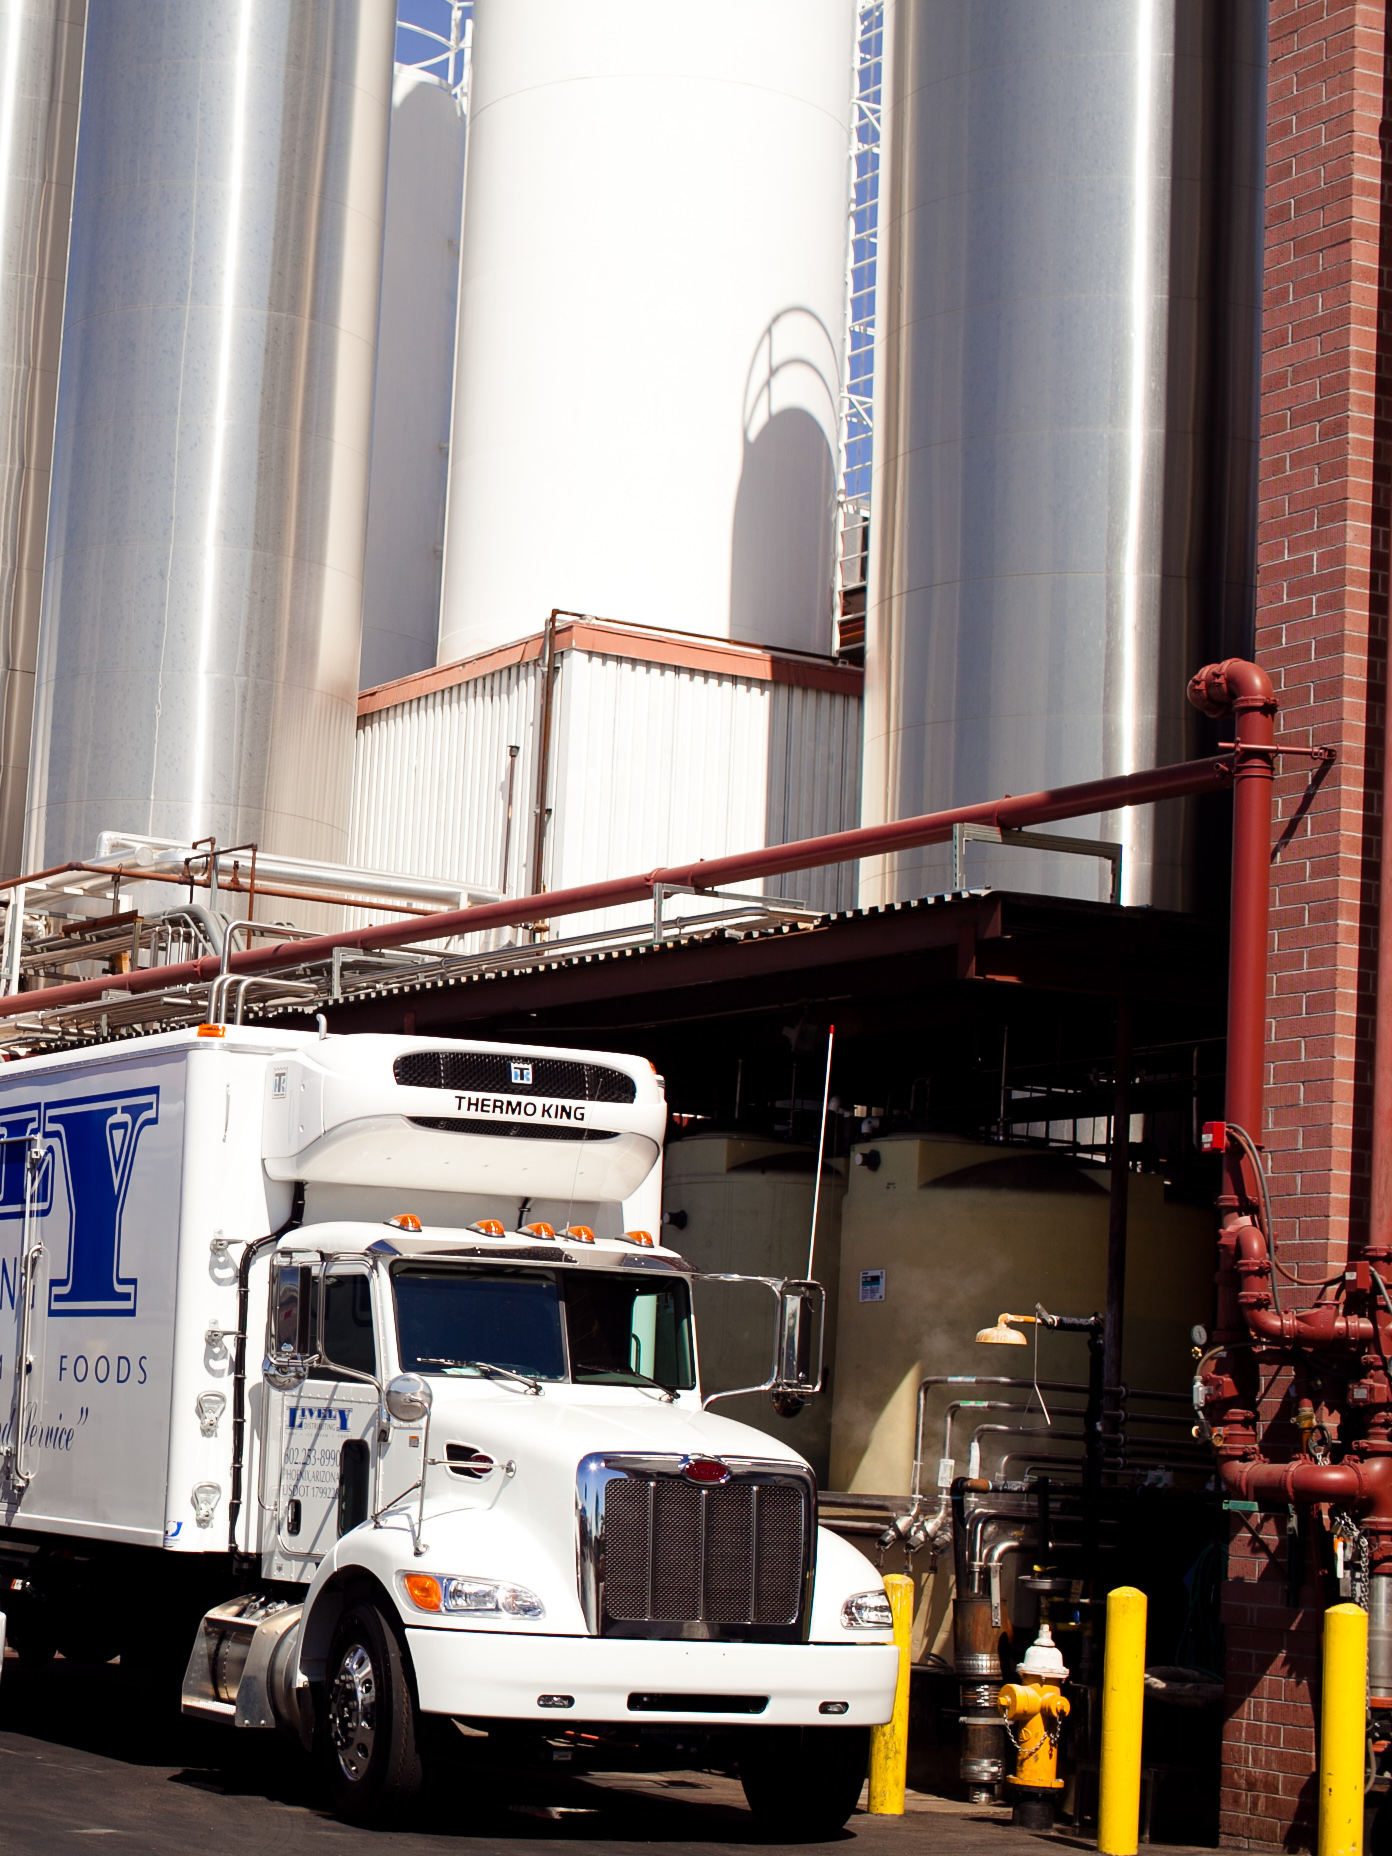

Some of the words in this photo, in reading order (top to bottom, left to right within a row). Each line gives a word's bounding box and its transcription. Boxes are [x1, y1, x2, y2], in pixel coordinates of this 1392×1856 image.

[455, 1095, 537, 1117] THERMO
[541, 1103, 586, 1121] KING
[58, 1354, 148, 1385] FOODS
[286, 1405, 353, 1432] LIVELY
[282, 1484, 310, 1498] USDOT
